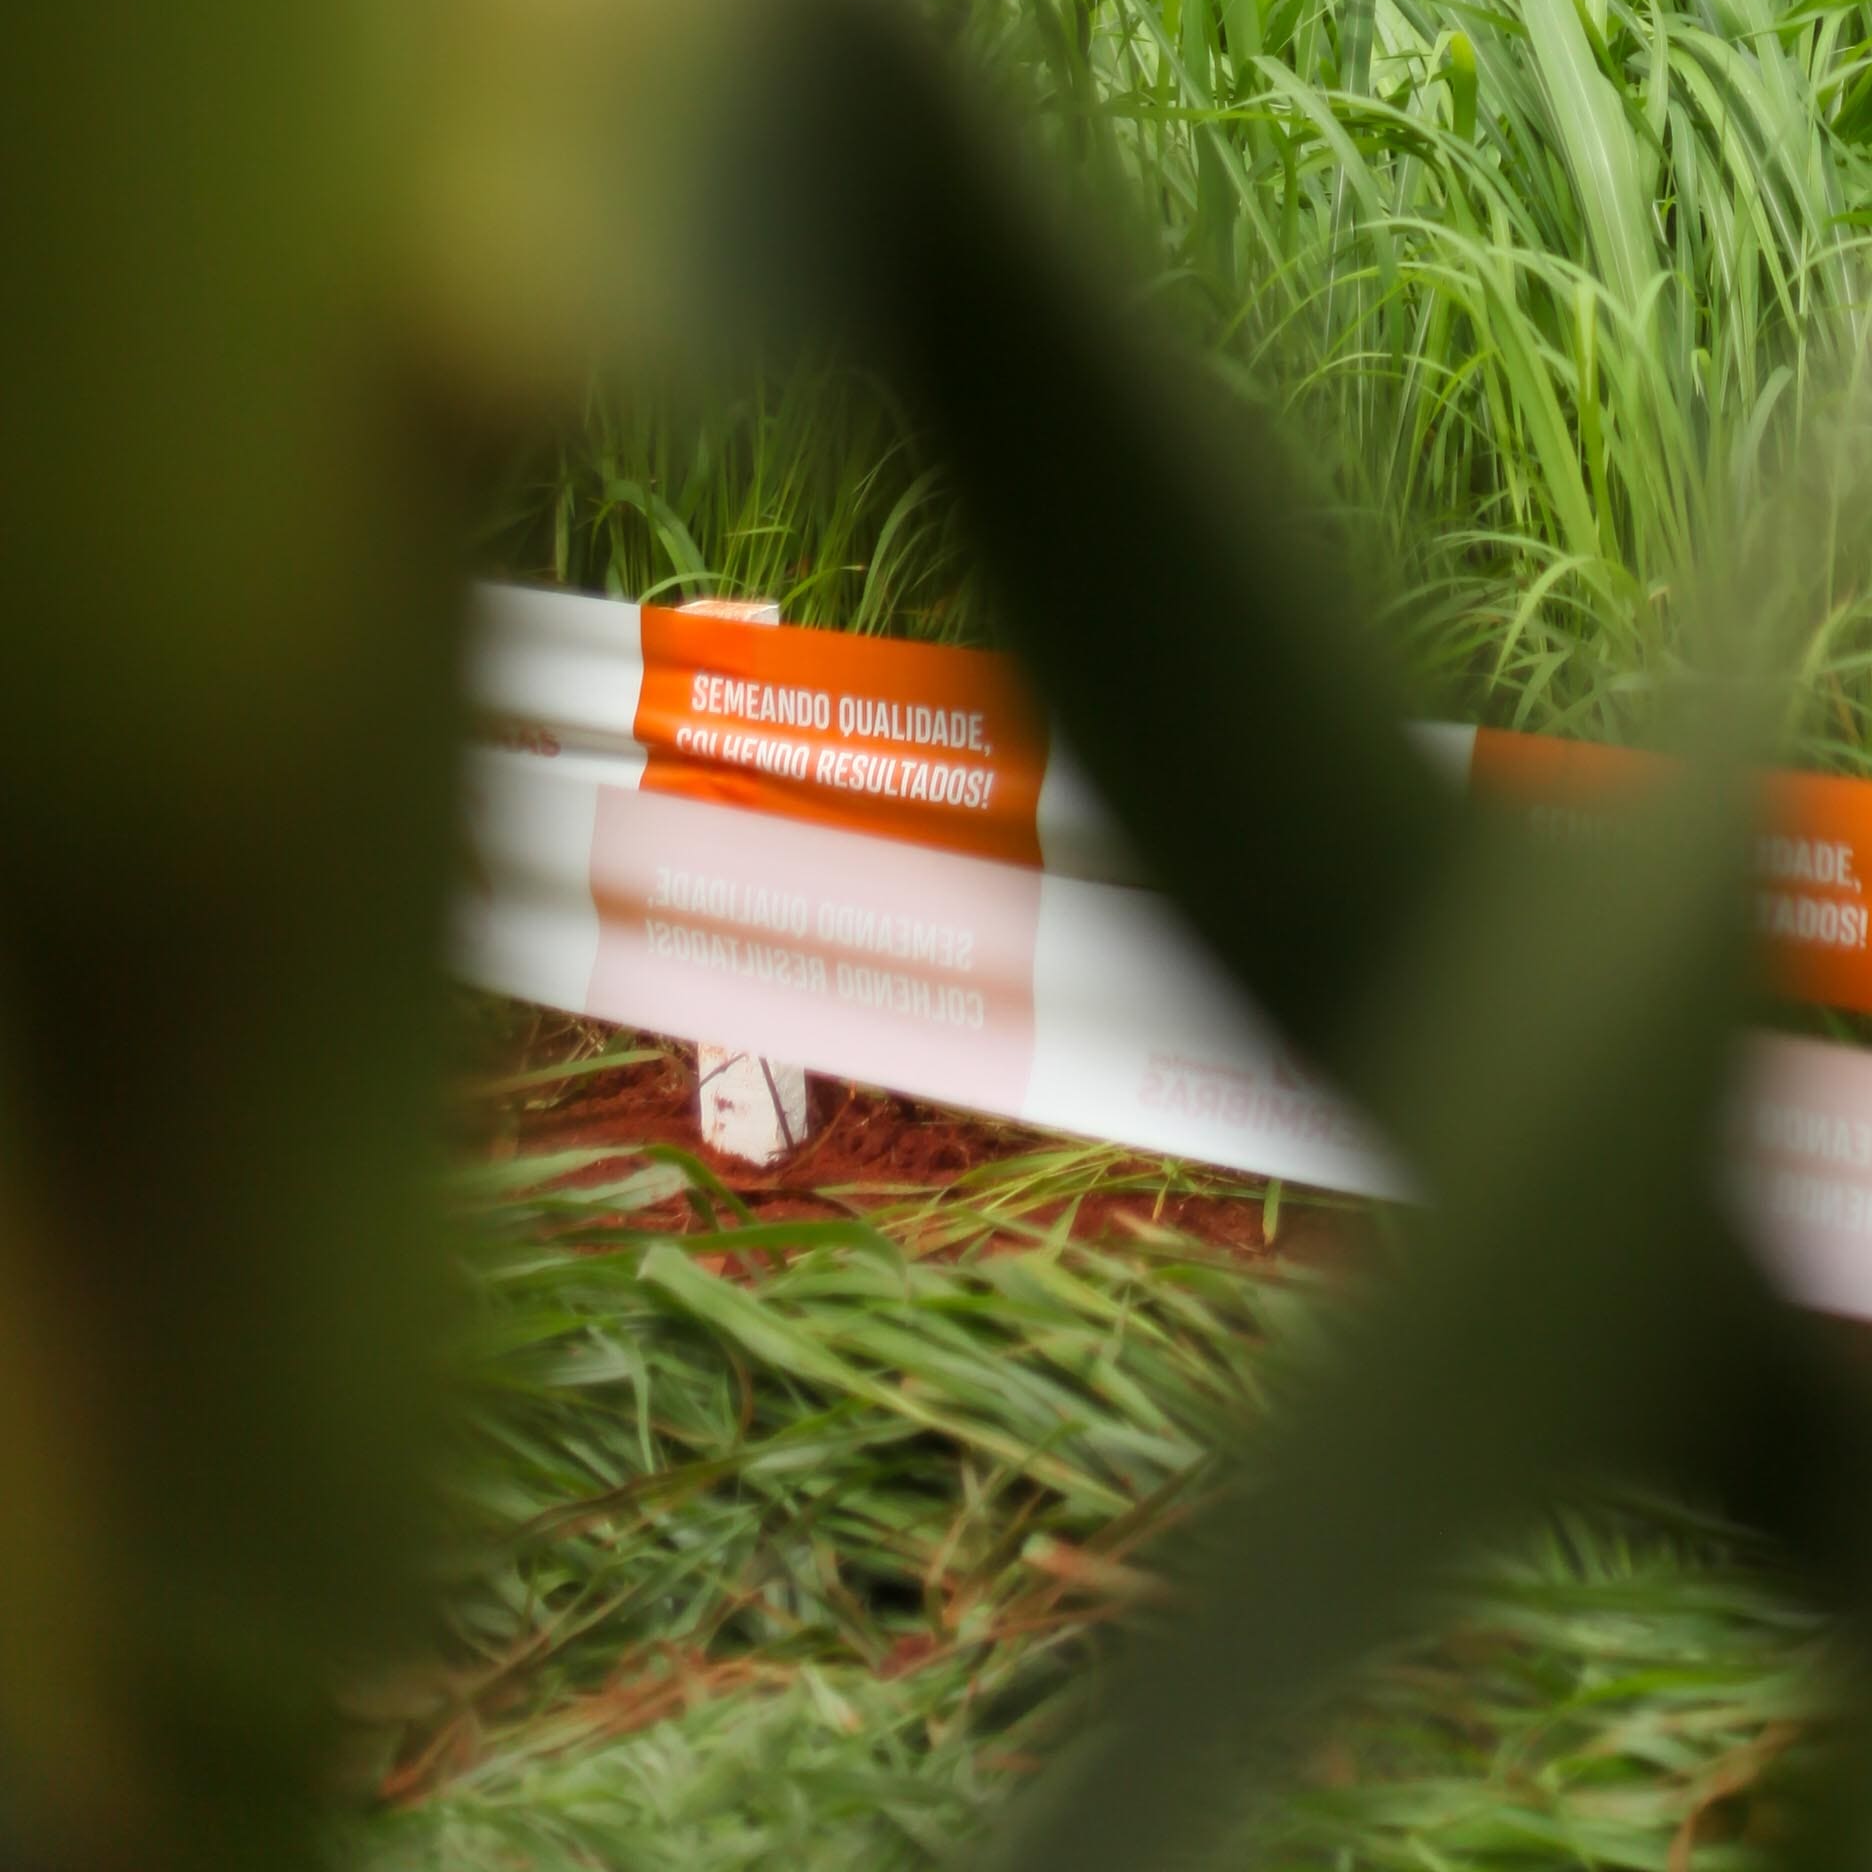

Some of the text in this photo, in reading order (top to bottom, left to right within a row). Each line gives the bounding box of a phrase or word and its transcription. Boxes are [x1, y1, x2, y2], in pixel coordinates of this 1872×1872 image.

[691, 673, 993, 758] SEMEANDO QUALIDADE,
[815, 747, 996, 810] RESULTADOS!
